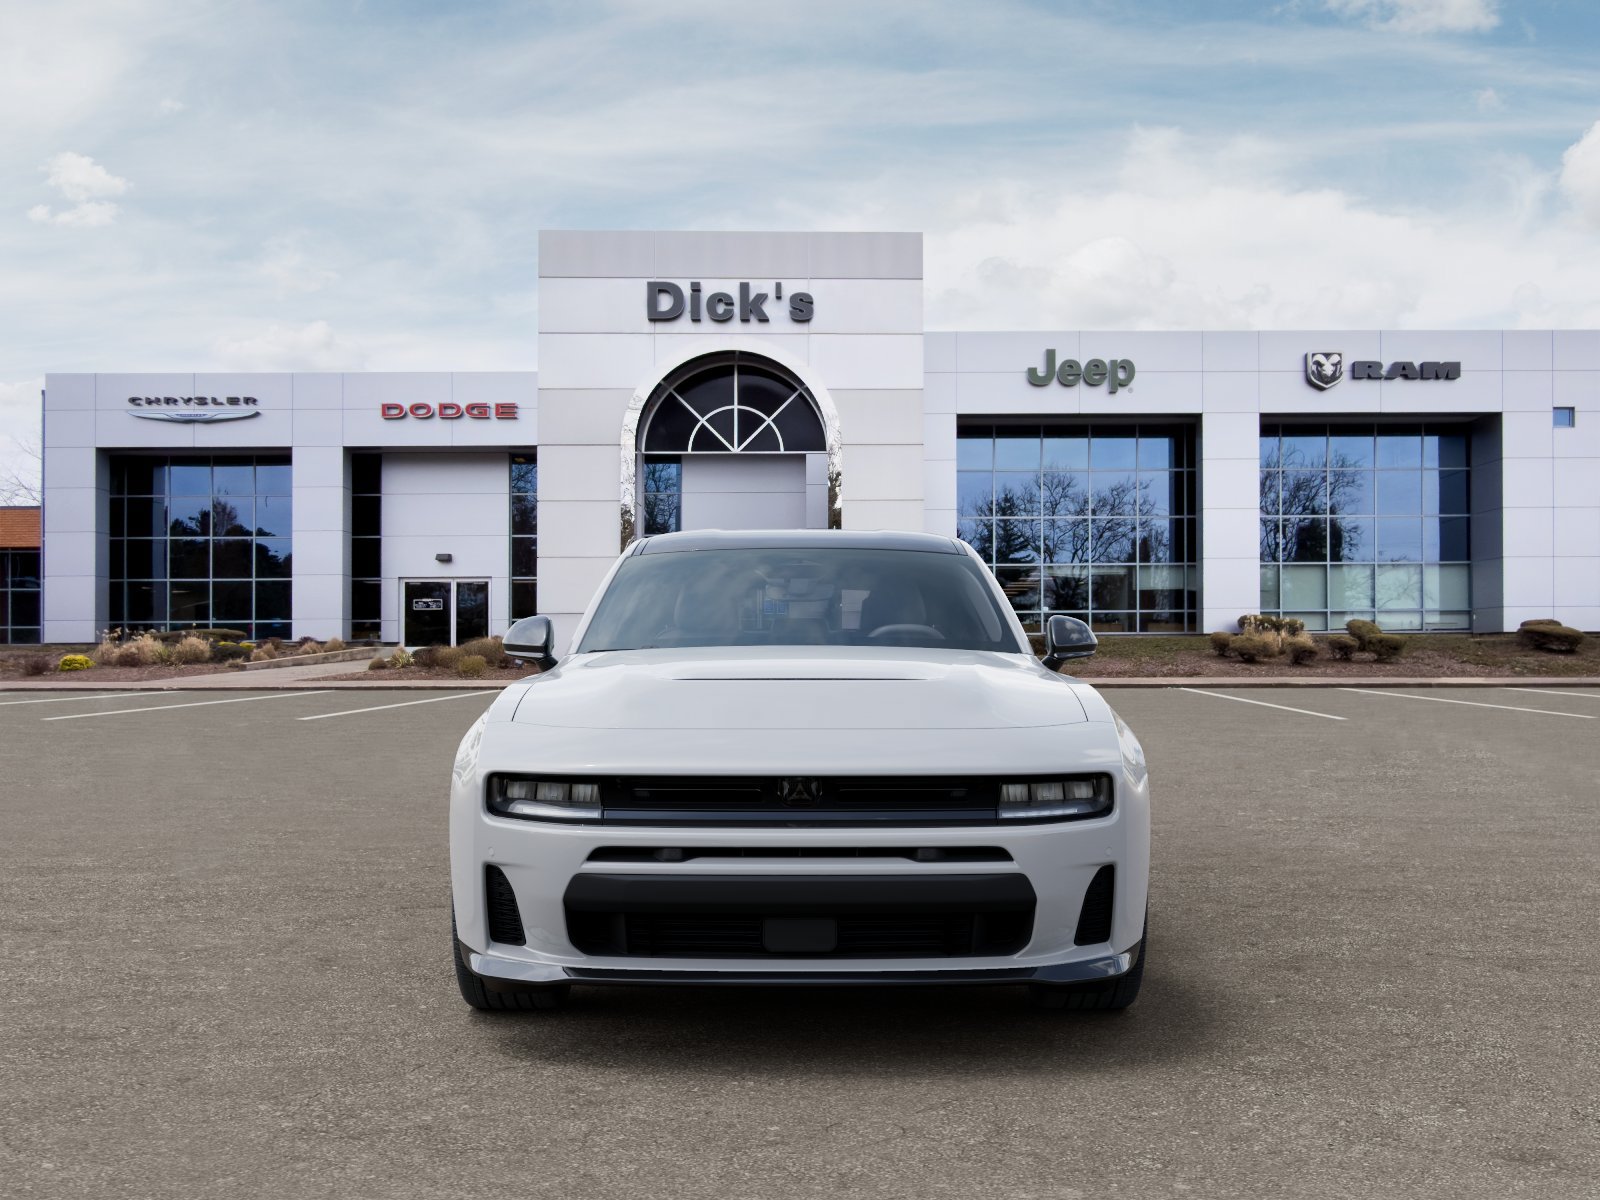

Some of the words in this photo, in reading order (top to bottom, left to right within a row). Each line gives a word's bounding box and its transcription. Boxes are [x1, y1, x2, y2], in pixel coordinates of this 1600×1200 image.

[647, 281, 814, 322] Dick's
[1027, 349, 1135, 394] Jeep
[1352, 361, 1461, 380] RAM
[127, 396, 258, 407] CHRYSLER
[381, 402, 519, 420] DODGE
